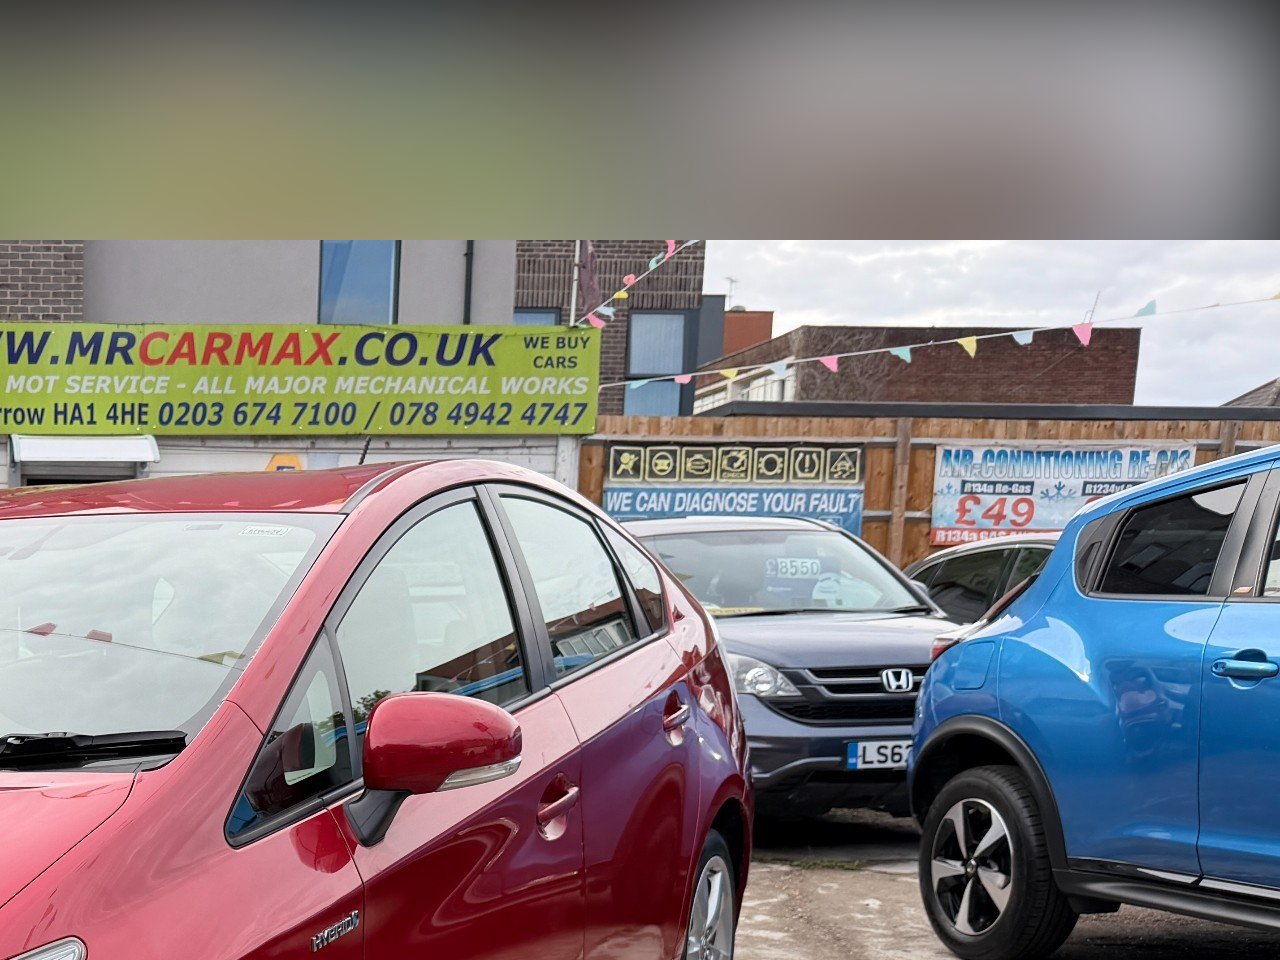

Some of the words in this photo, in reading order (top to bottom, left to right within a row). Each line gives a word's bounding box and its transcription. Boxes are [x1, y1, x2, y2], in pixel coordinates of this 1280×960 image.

[523, 337, 552, 350] WE
[556, 337, 590, 350] BUY
[532, 356, 578, 369] CARS
[5, 375, 59, 394] MOT
[65, 375, 168, 394] SERVICE
[193, 376, 236, 394] ALL
[244, 376, 328, 394] MAJOR
[334, 376, 491, 394] MECHANICAL
[501, 376, 588, 394] WORKS
[54, 402, 98, 425] HA1
[106, 402, 149, 425] 4HE
[158, 402, 223, 426] 0203
[232, 402, 282, 426] 674
[293, 402, 357, 426] 7100
[389, 402, 438, 426] 078
[447, 402, 512, 426] 4942
[520, 402, 588, 426] 4747
[939, 449, 1122, 479] AIR-CONDITIONING
[964, 483, 994, 493] R134a
[995, 483, 1032, 494] Re-Gas
[607, 492, 632, 511] WE
[636, 492, 671, 512] CAN
[674, 492, 759, 512] DIAGNOSE
[763, 492, 806, 512] YOUR
[809, 492, 860, 513] FAULT
[955, 495, 1035, 527] £49
[935, 530, 978, 541] R134a
[863, 744, 914, 765] LS6
